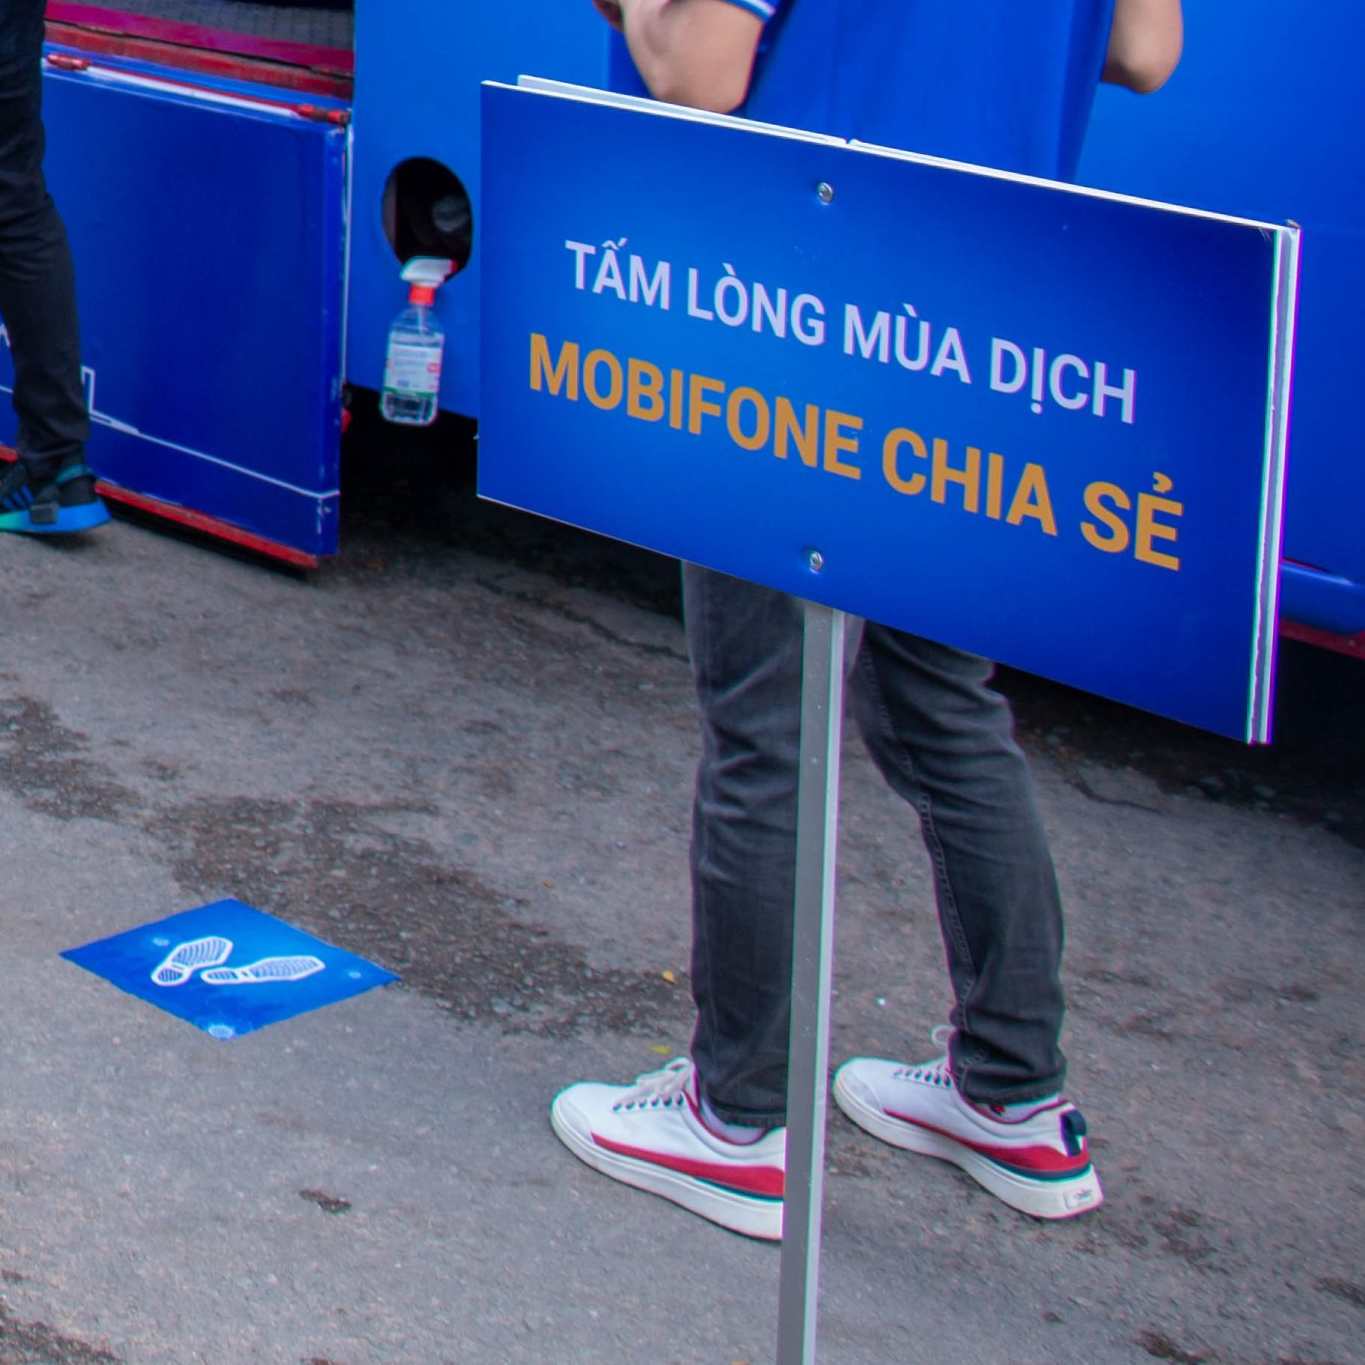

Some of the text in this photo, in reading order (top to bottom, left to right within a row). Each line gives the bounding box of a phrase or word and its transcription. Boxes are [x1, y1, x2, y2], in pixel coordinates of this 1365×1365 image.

[565, 236, 1138, 425] TẤM LÒNG MÙA DỊCH
[528, 332, 864, 482] MOBIFONE
[881, 427, 1059, 538] CHIA
[1079, 470, 1185, 573] SẺ
